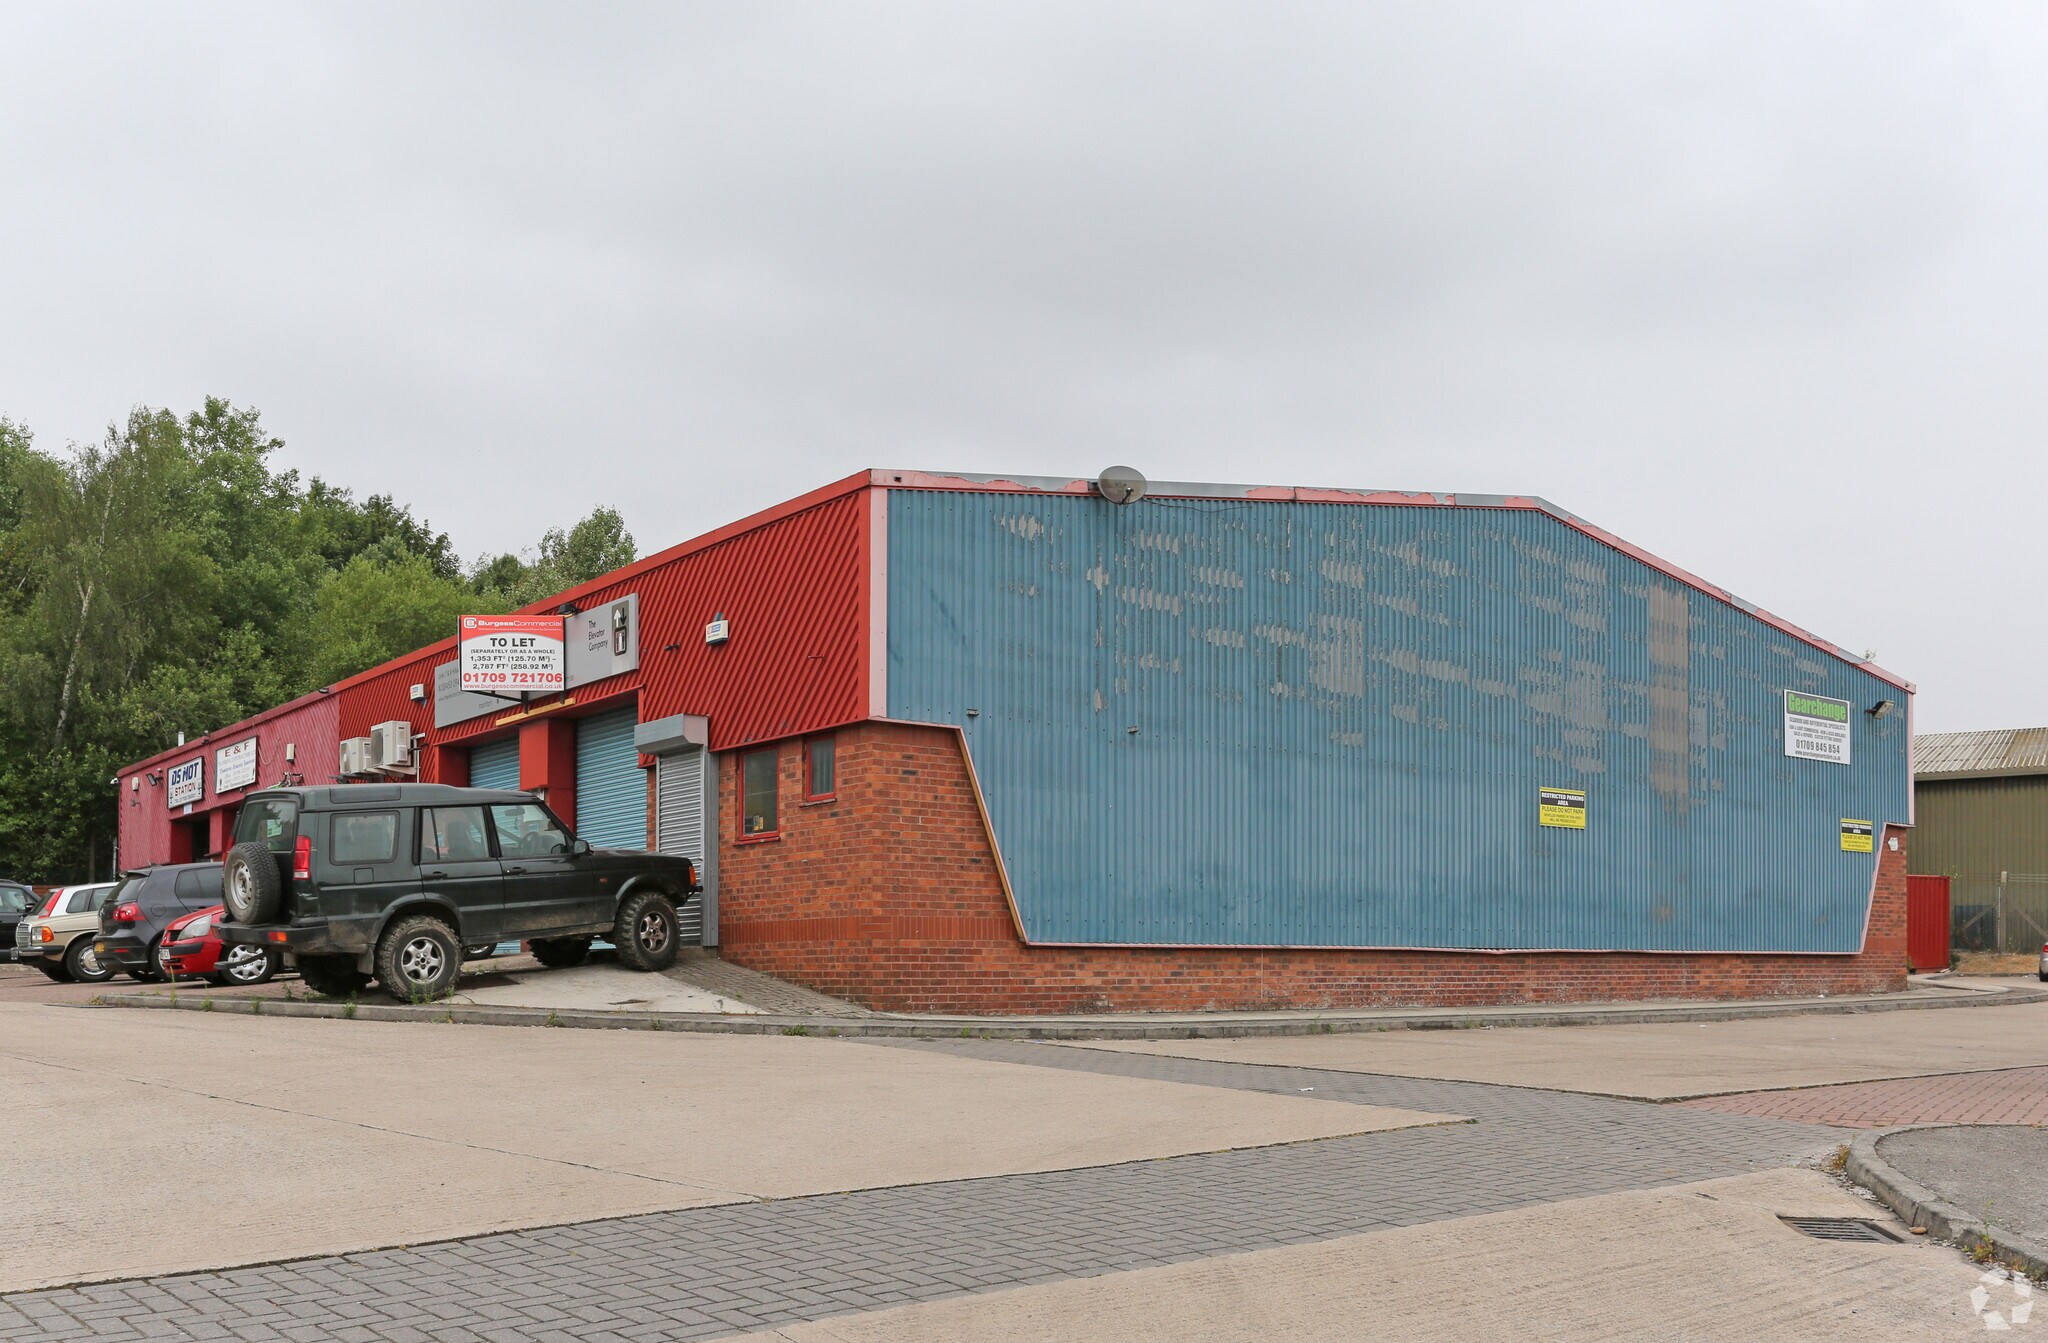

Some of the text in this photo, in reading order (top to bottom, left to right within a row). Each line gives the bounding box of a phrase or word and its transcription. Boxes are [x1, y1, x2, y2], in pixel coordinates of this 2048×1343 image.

[490, 638, 536, 647] TO LET
[463, 673, 506, 682] 01709
[512, 673, 562, 682] 721706
[1788, 693, 1846, 721] Gearchange
[225, 742, 250, 757] E & F
[1796, 739, 1840, 754] 01709 845 854
[182, 762, 199, 782] MOT
[175, 782, 196, 796] STATION
